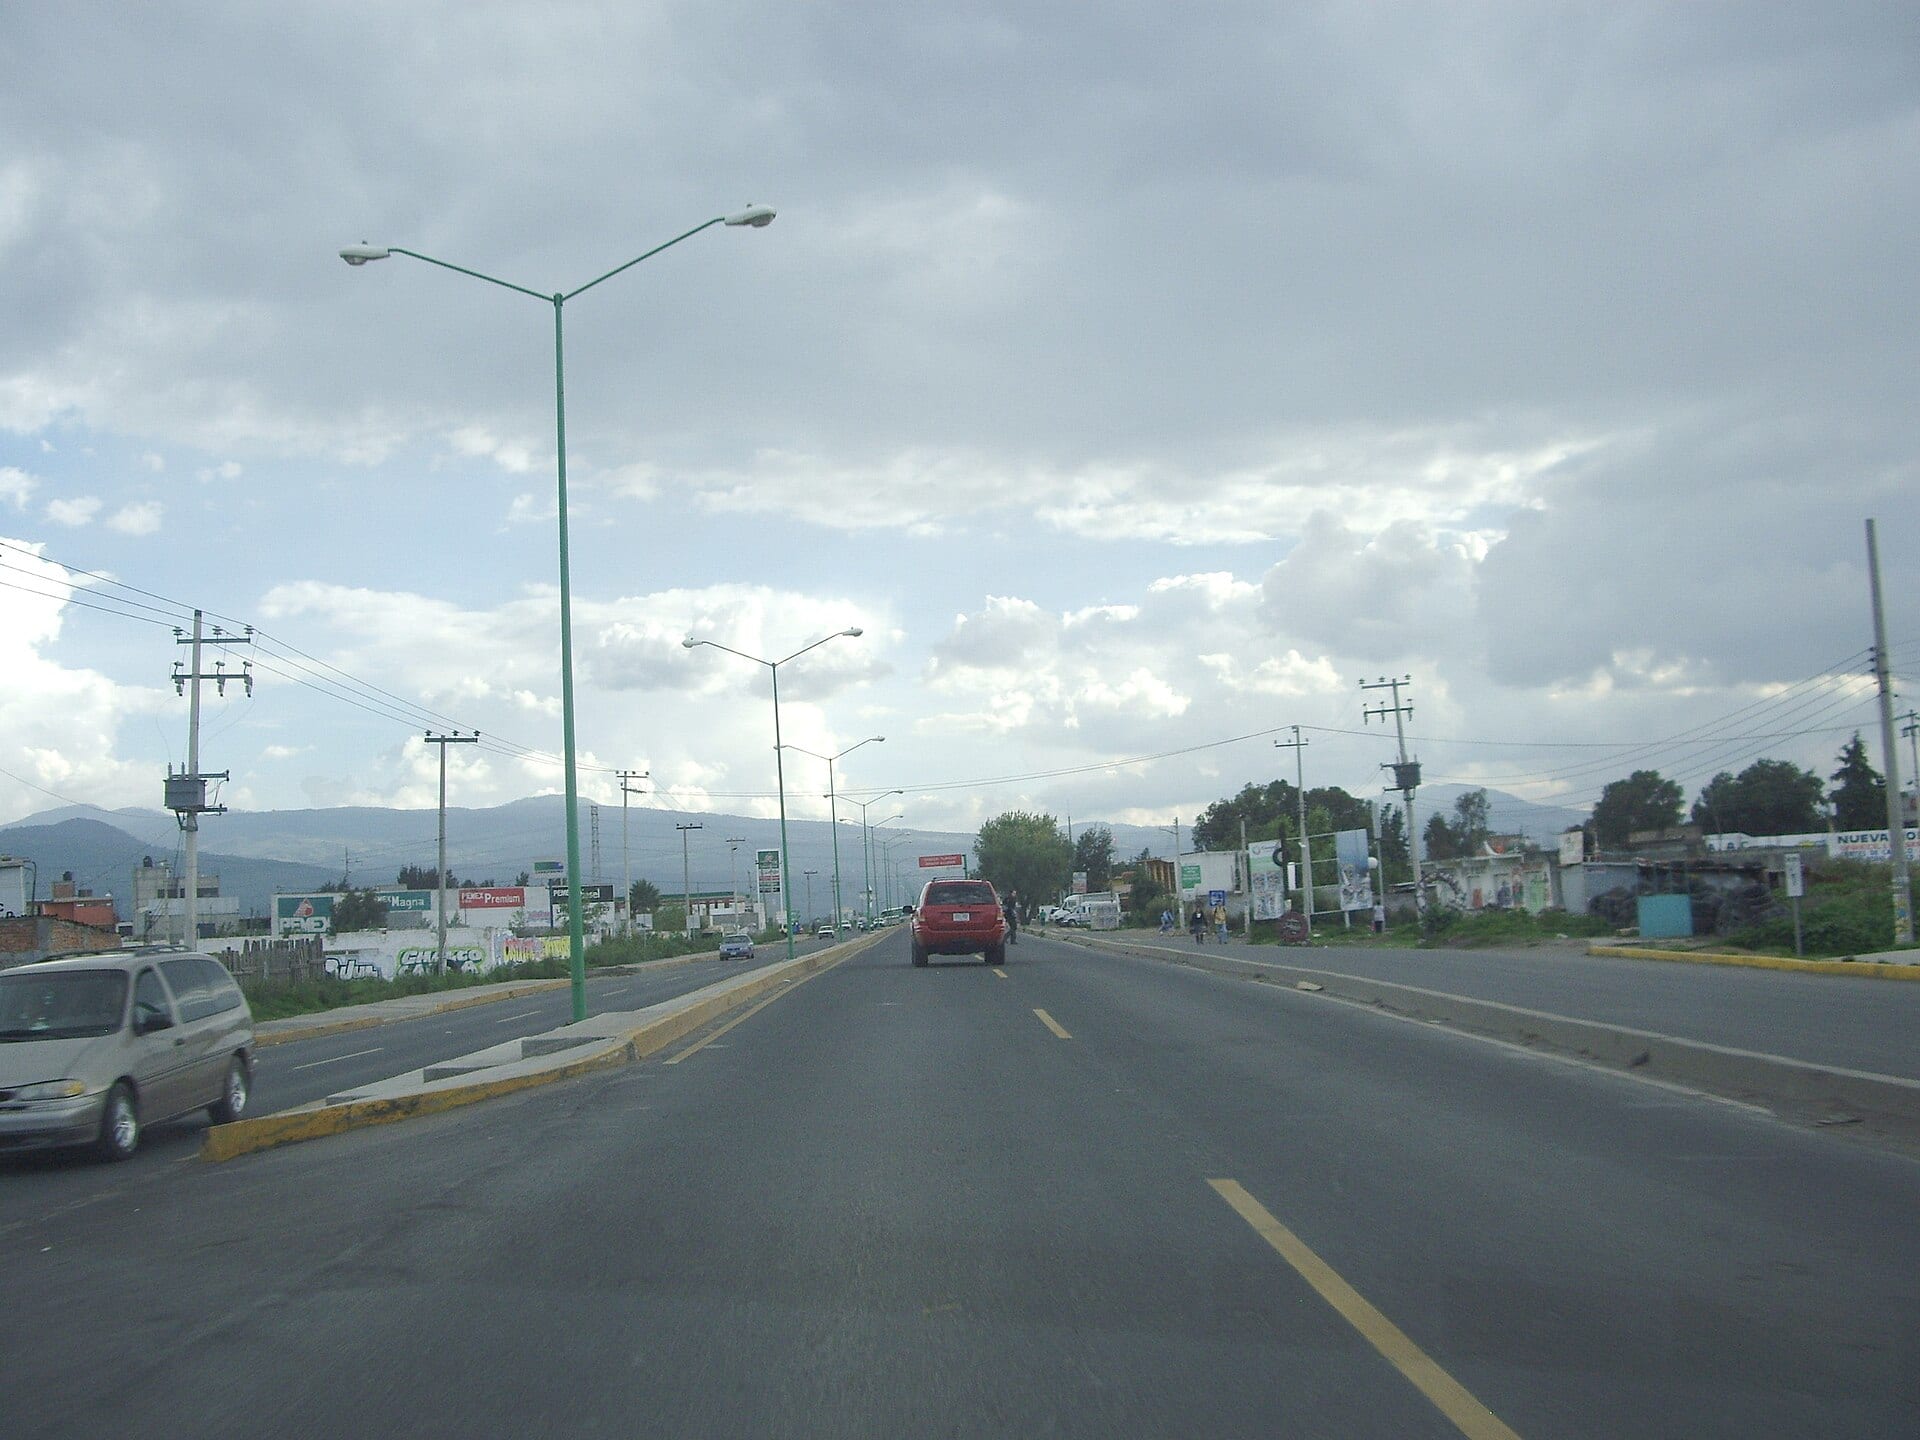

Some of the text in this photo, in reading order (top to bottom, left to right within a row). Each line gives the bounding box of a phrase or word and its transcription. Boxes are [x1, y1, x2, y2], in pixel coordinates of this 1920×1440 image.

[1838, 833, 1889, 844] NUEVA
[391, 895, 425, 910] Magna
[484, 893, 521, 905] Premium
